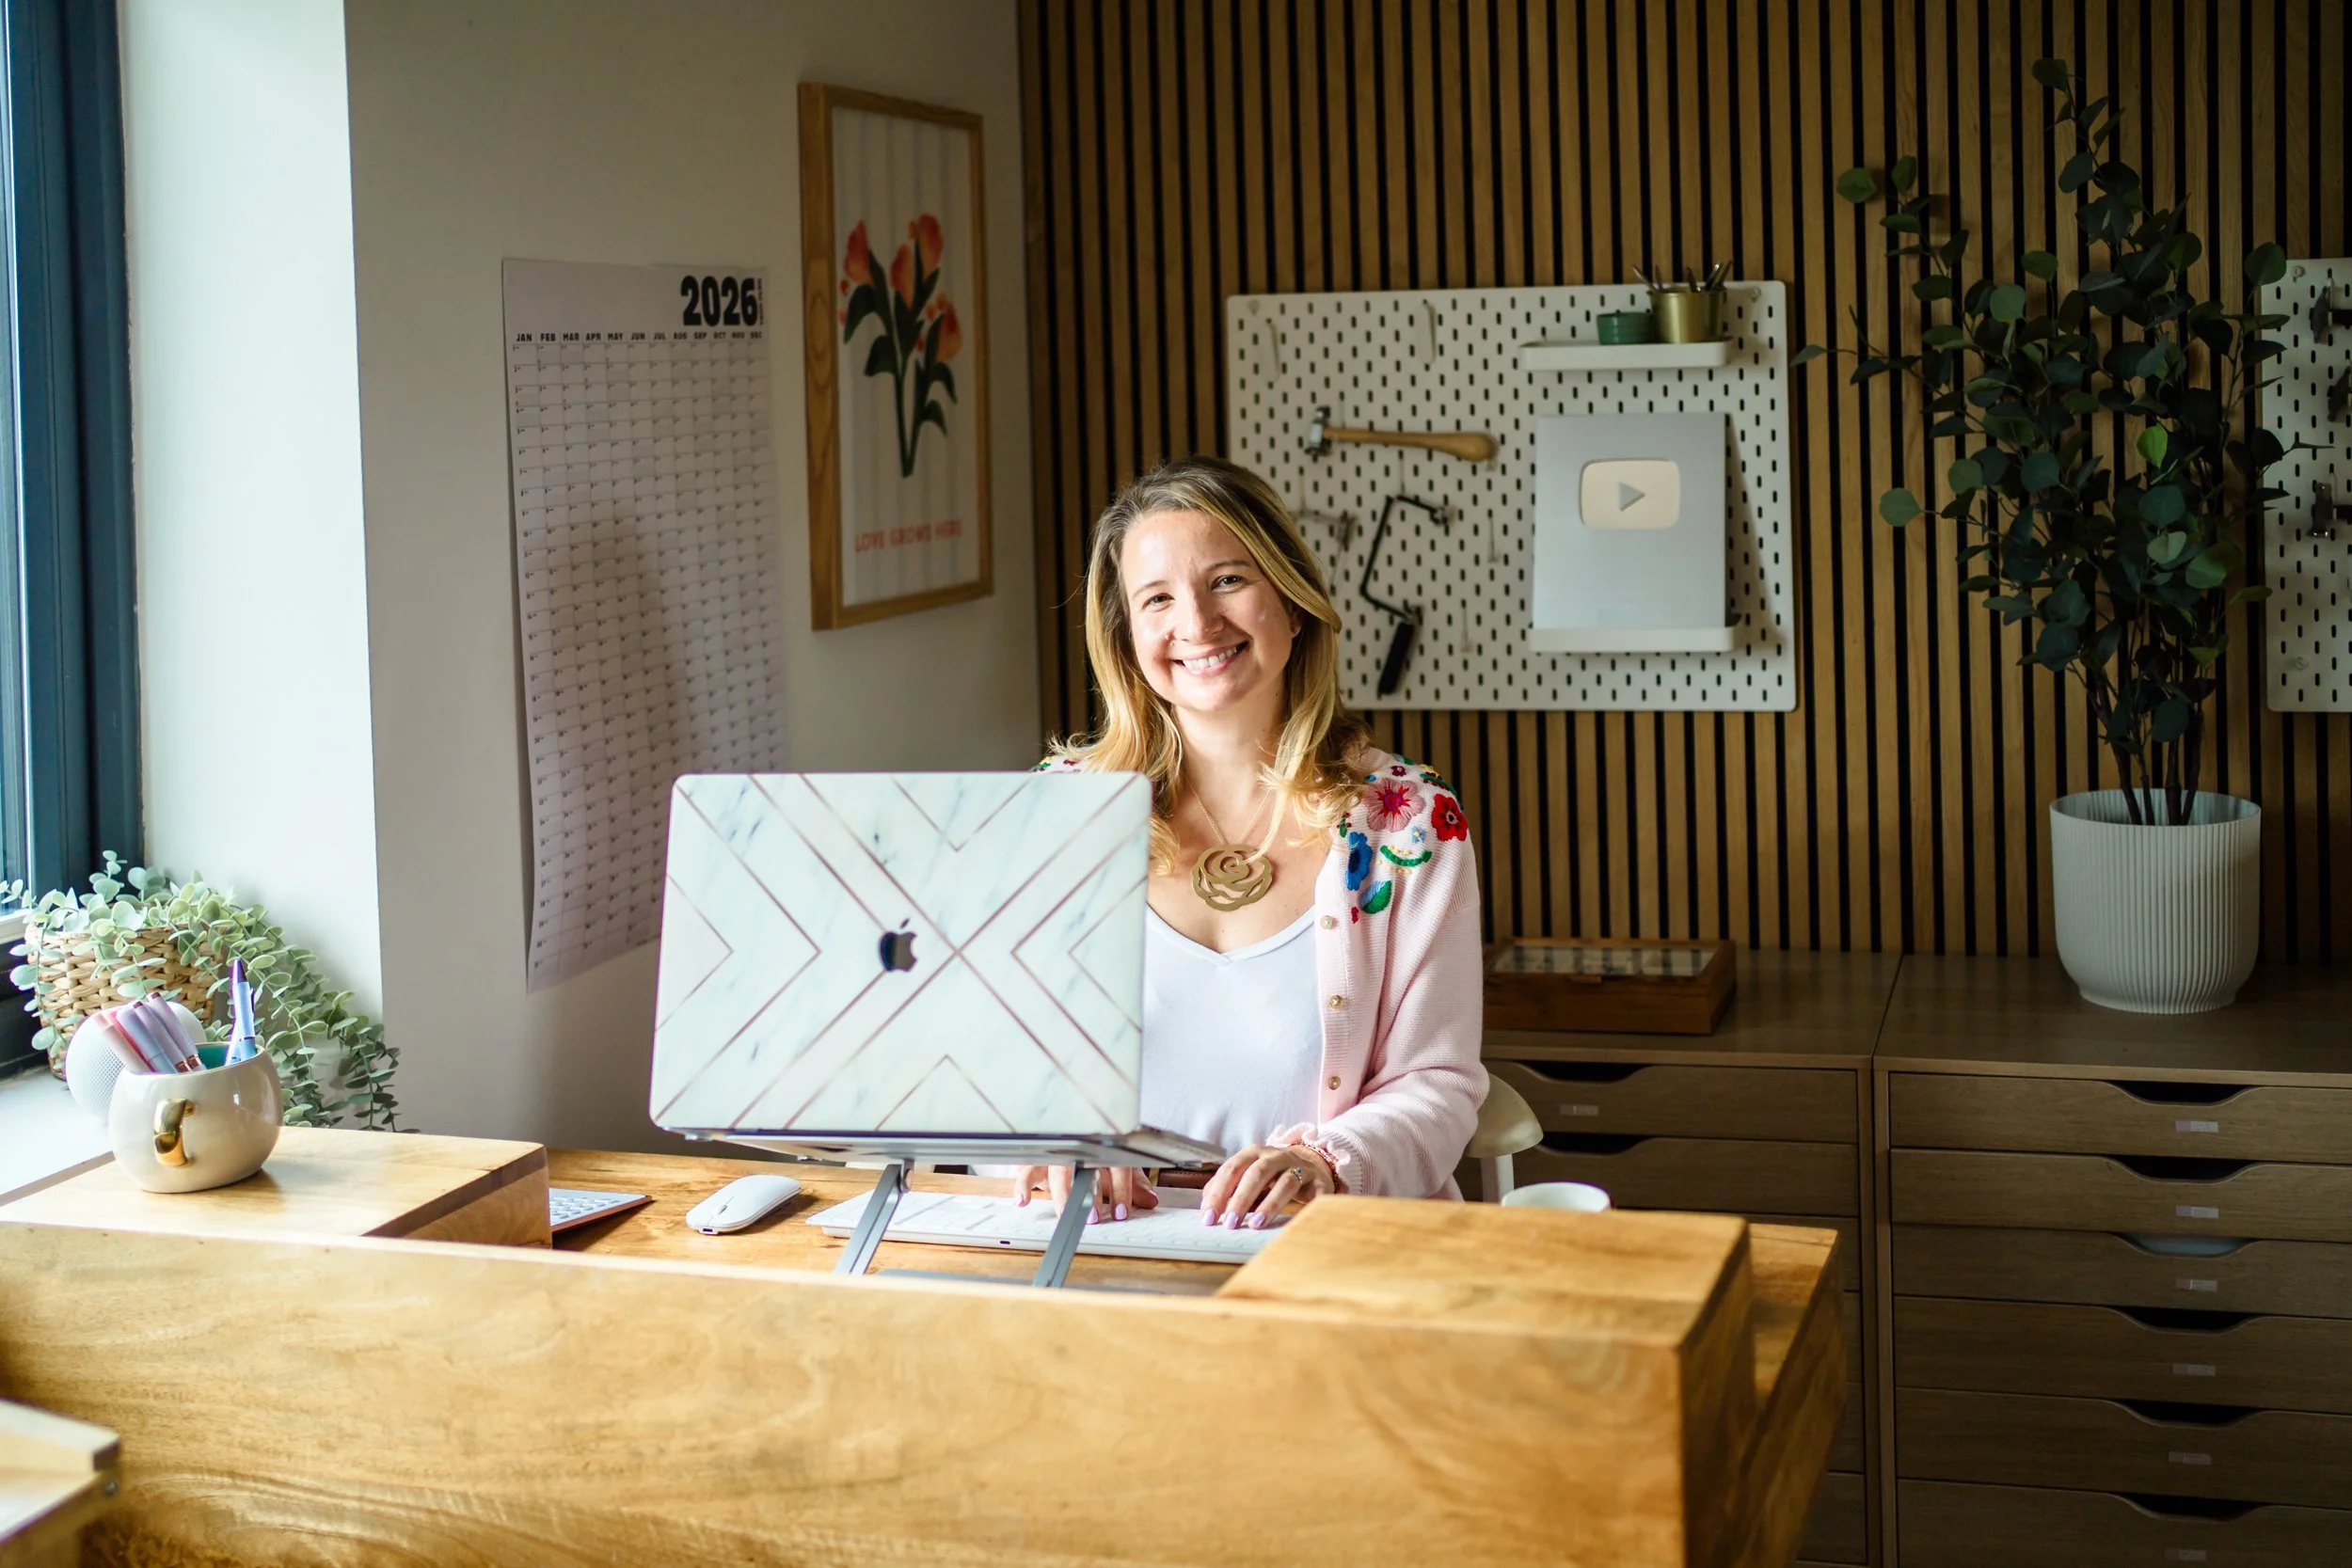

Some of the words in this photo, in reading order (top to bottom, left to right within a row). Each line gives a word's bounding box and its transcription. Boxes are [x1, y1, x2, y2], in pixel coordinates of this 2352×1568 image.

[680, 275, 757, 326] 2026
[516, 333, 532, 341] JAN
[540, 333, 556, 341] FEB
[608, 332, 624, 341] MAY
[630, 332, 645, 341] JUN
[855, 531, 885, 553] LOVE
